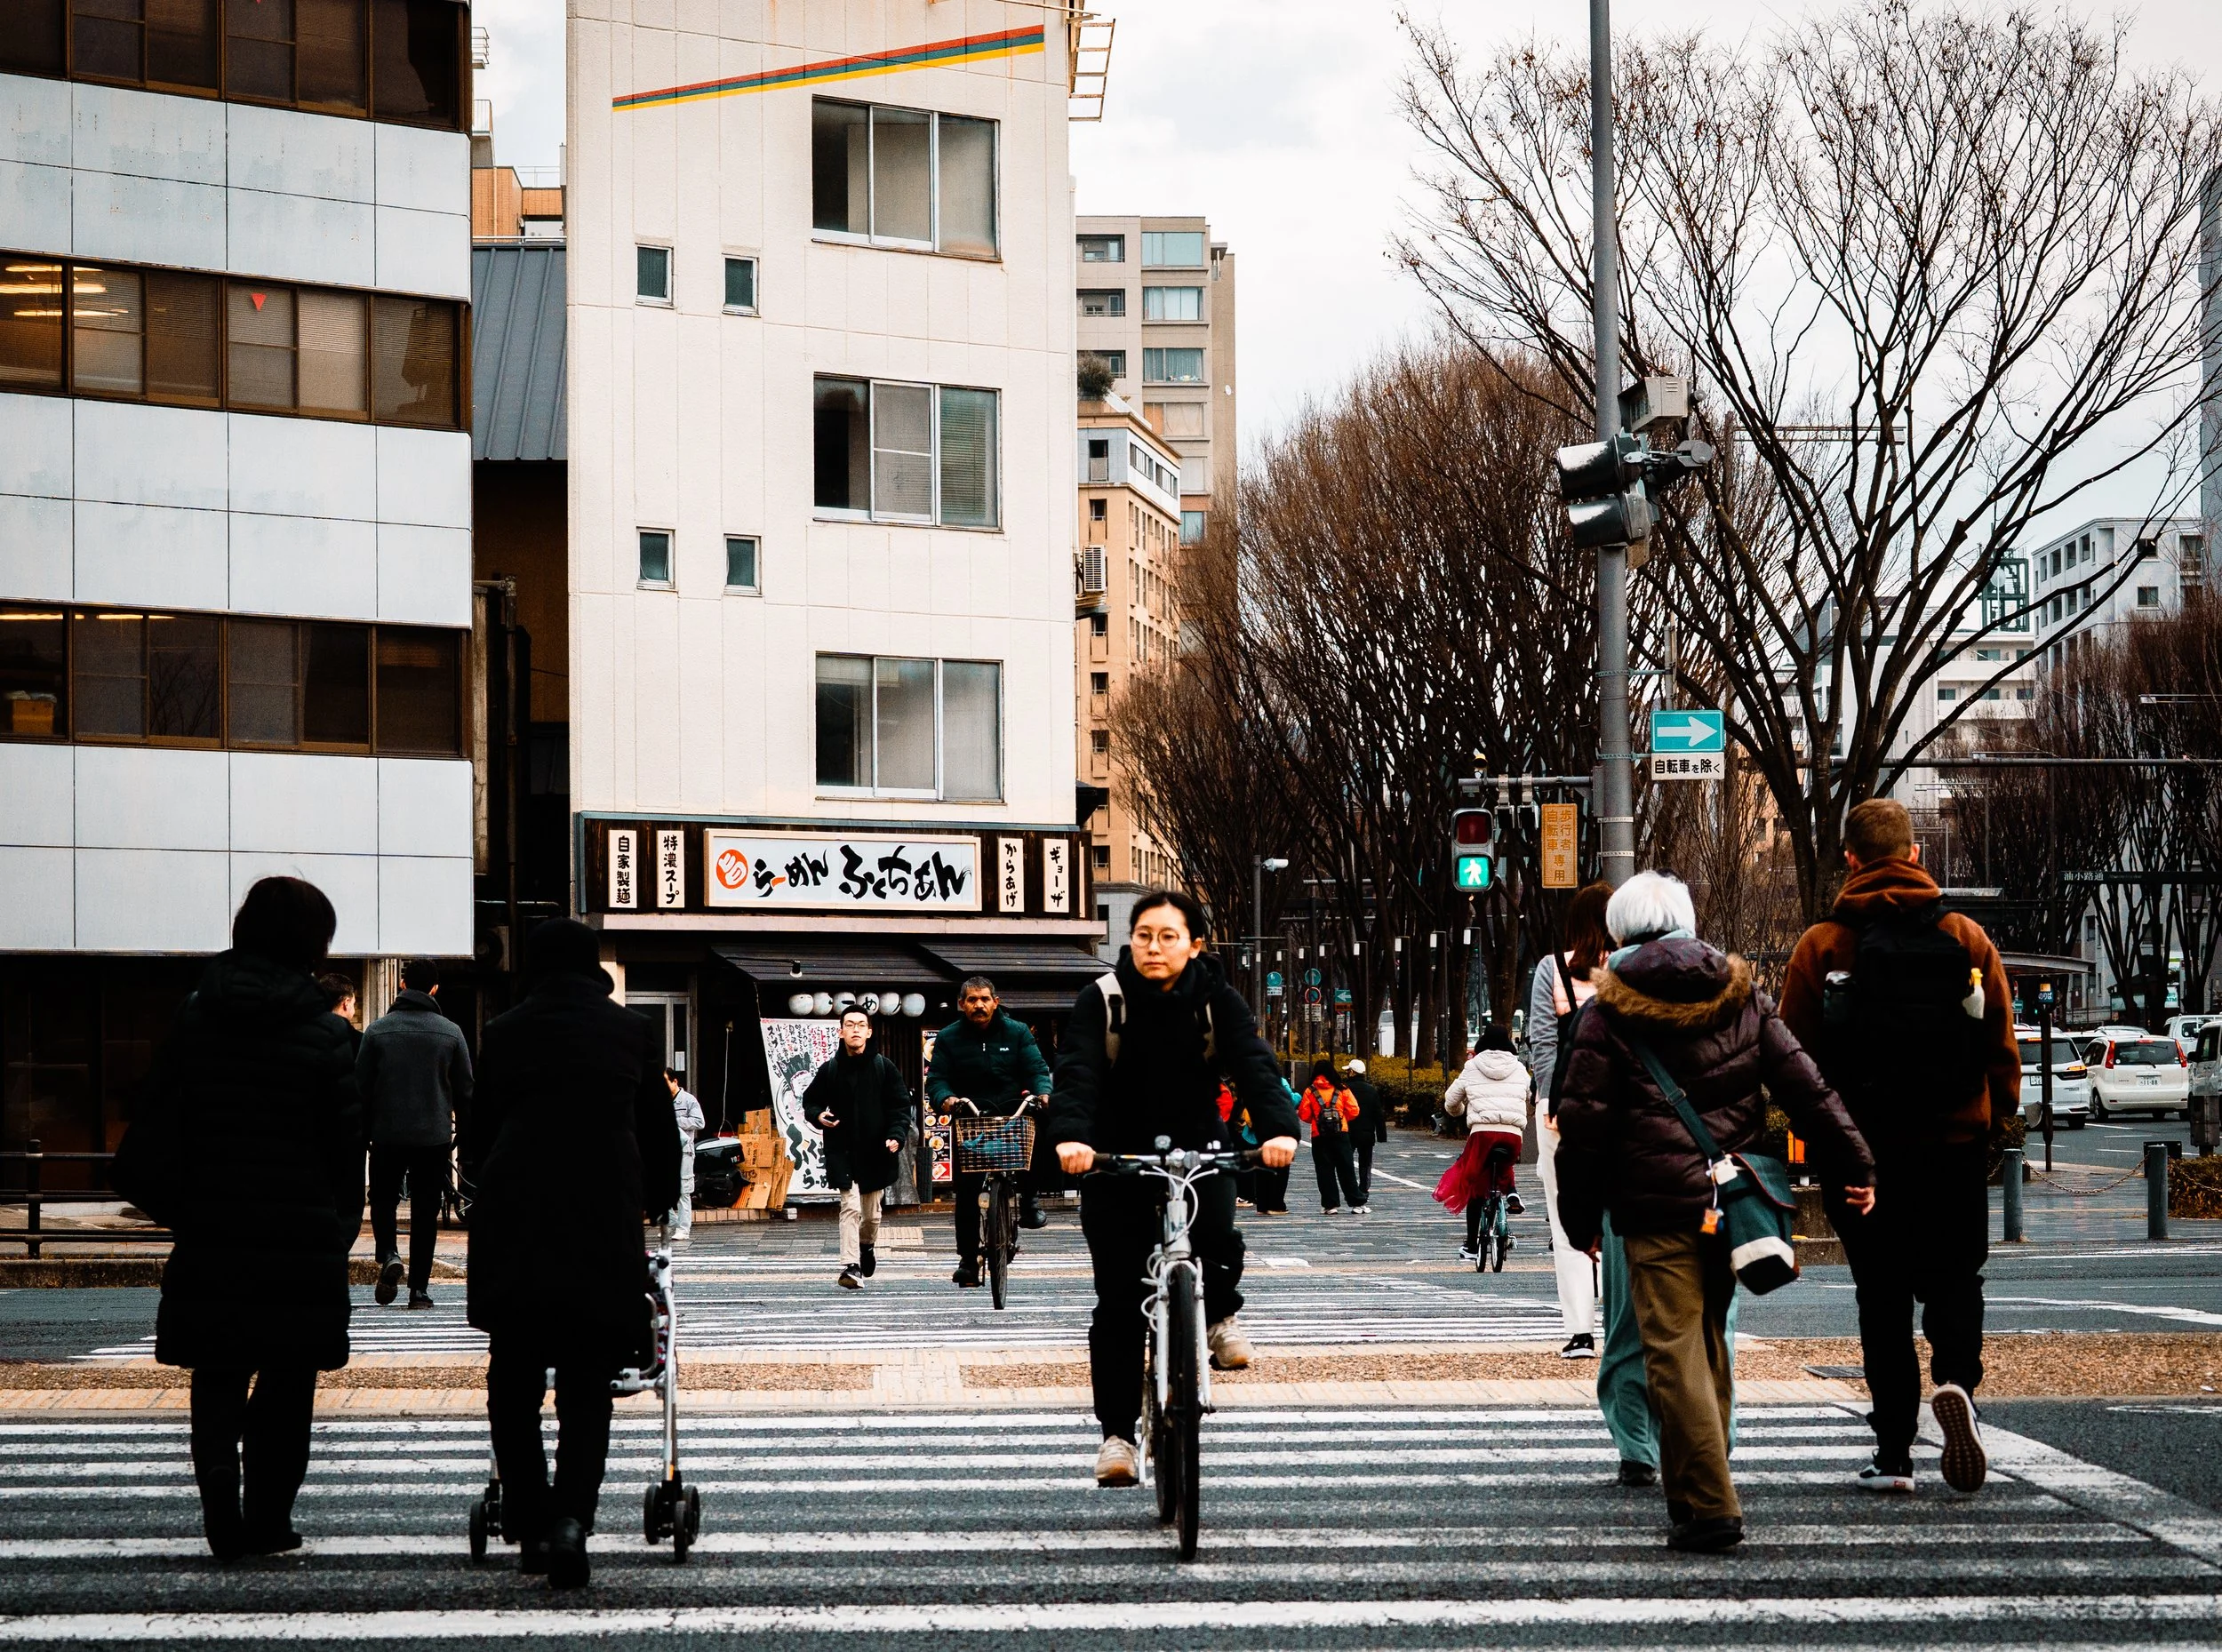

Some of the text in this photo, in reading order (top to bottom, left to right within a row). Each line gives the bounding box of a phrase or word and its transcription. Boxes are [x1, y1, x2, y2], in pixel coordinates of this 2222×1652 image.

[1654, 758, 1721, 774] 自転車を除く
[1547, 810, 1558, 850] 自転車
[1560, 810, 1571, 850] 歩行者
[616, 835, 630, 904] 自家製麺
[663, 834, 679, 905] 特濃スープ
[839, 844, 971, 902] ふくちあん
[1004, 843, 1018, 907] からあげ
[1049, 846, 1065, 907] ギョーザ
[1554, 854, 1565, 882] 専用
[2064, 872, 2104, 881] 油小路通
